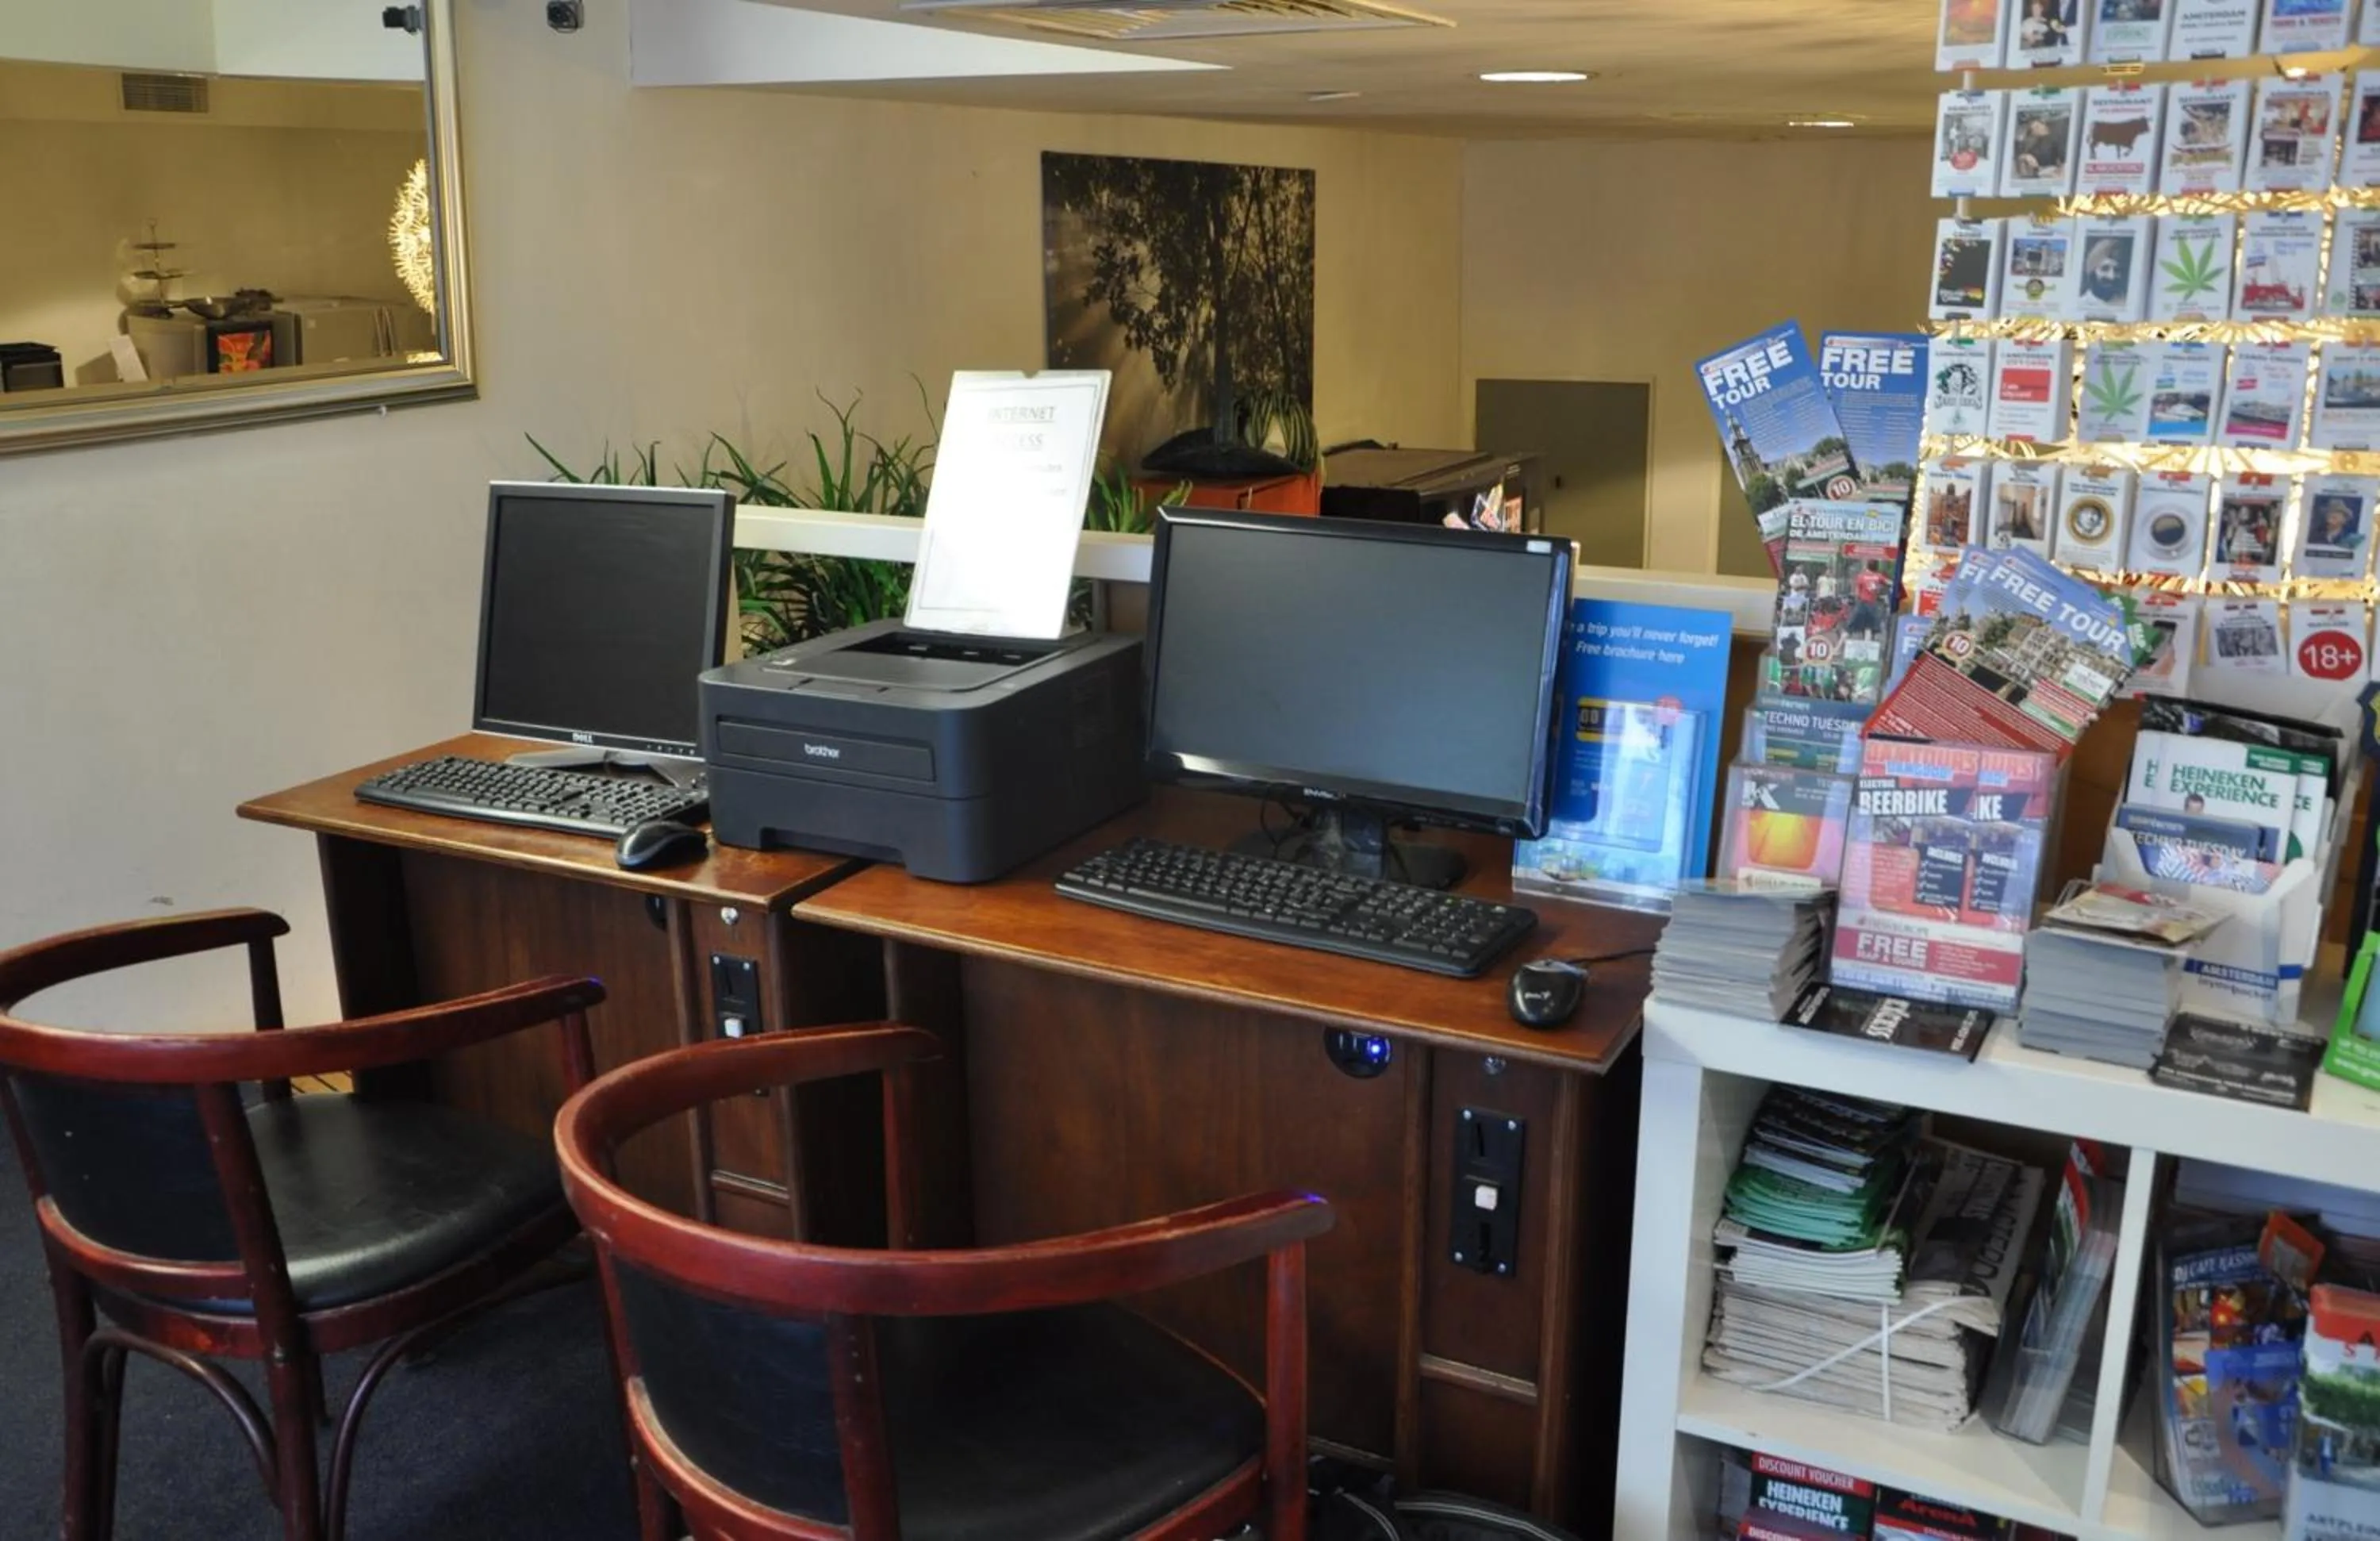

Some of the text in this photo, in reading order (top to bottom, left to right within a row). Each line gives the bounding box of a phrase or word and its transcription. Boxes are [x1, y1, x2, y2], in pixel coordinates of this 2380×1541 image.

[1703, 340, 1794, 396] FREE
[1821, 346, 1915, 375] FREE
[1712, 375, 1772, 410] TOUR
[1821, 371, 1881, 390] TOUR
[1832, 479, 1850, 496] 10
[1791, 514, 1806, 528] EL
[1810, 515, 1843, 530] TOUR
[1846, 517, 1865, 531] EN
[1990, 565, 2057, 614] FREE
[2057, 603, 2127, 652] TOUR
[1587, 621, 1608, 638] trip
[1642, 628, 1678, 643] never
[1679, 629, 1719, 649] forget!
[1949, 636, 1968, 652] 10
[1576, 640, 1686, 664] Free brochure here
[1808, 642, 1825, 656] 10
[2303, 644, 2359, 671] 18+
[573, 732, 593, 744] DELL
[804, 743, 841, 758] brother
[2171, 763, 2267, 791] HEINEKEN
[1859, 789, 1948, 817] BEERBIKE
[2169, 778, 2280, 809] EXPERIENCE
[1857, 932, 1929, 959] FREE
[1758, 1455, 1854, 1491] DISCOUNT VOUCHER
[1766, 1479, 1843, 1514] HEINEKEN
